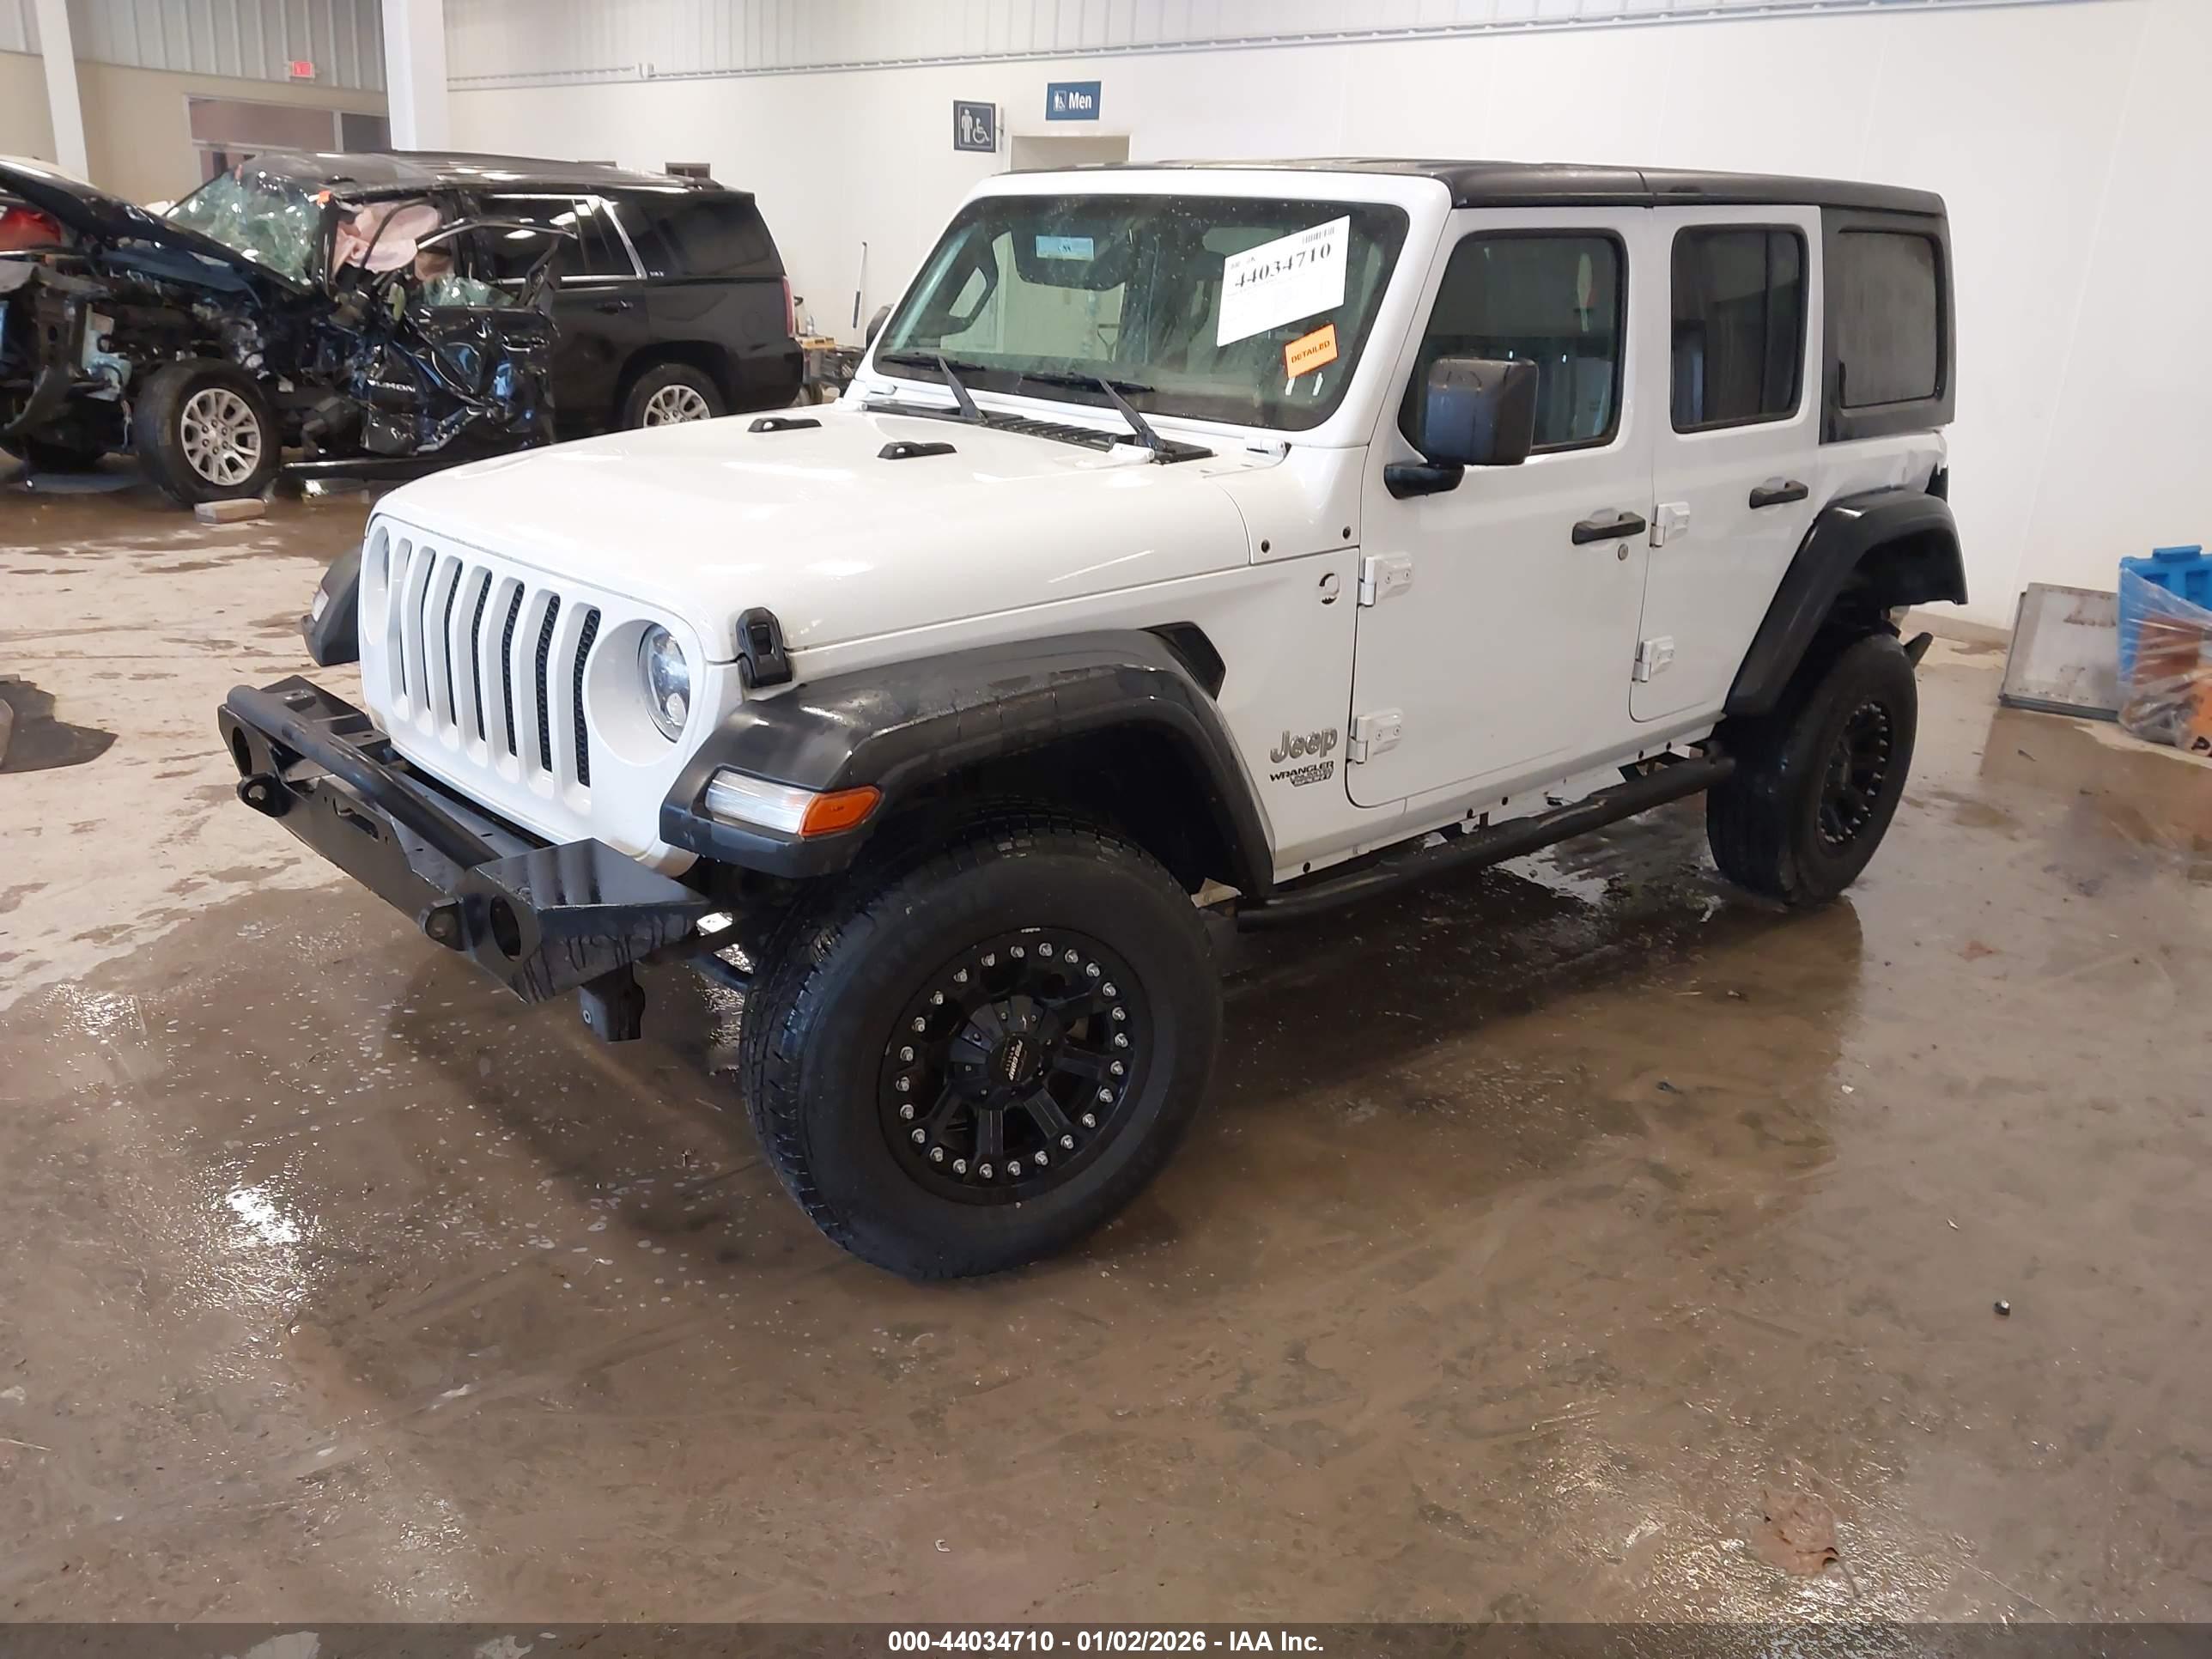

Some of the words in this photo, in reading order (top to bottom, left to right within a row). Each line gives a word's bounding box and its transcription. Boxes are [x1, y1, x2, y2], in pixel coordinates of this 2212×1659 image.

[1068, 91, 1092, 110] Men
[1235, 244, 1331, 288] 44034710
[1291, 340, 1330, 363] DETAILED
[1270, 727, 1338, 763] Jeep
[1269, 760, 1334, 781] WRANGLER
